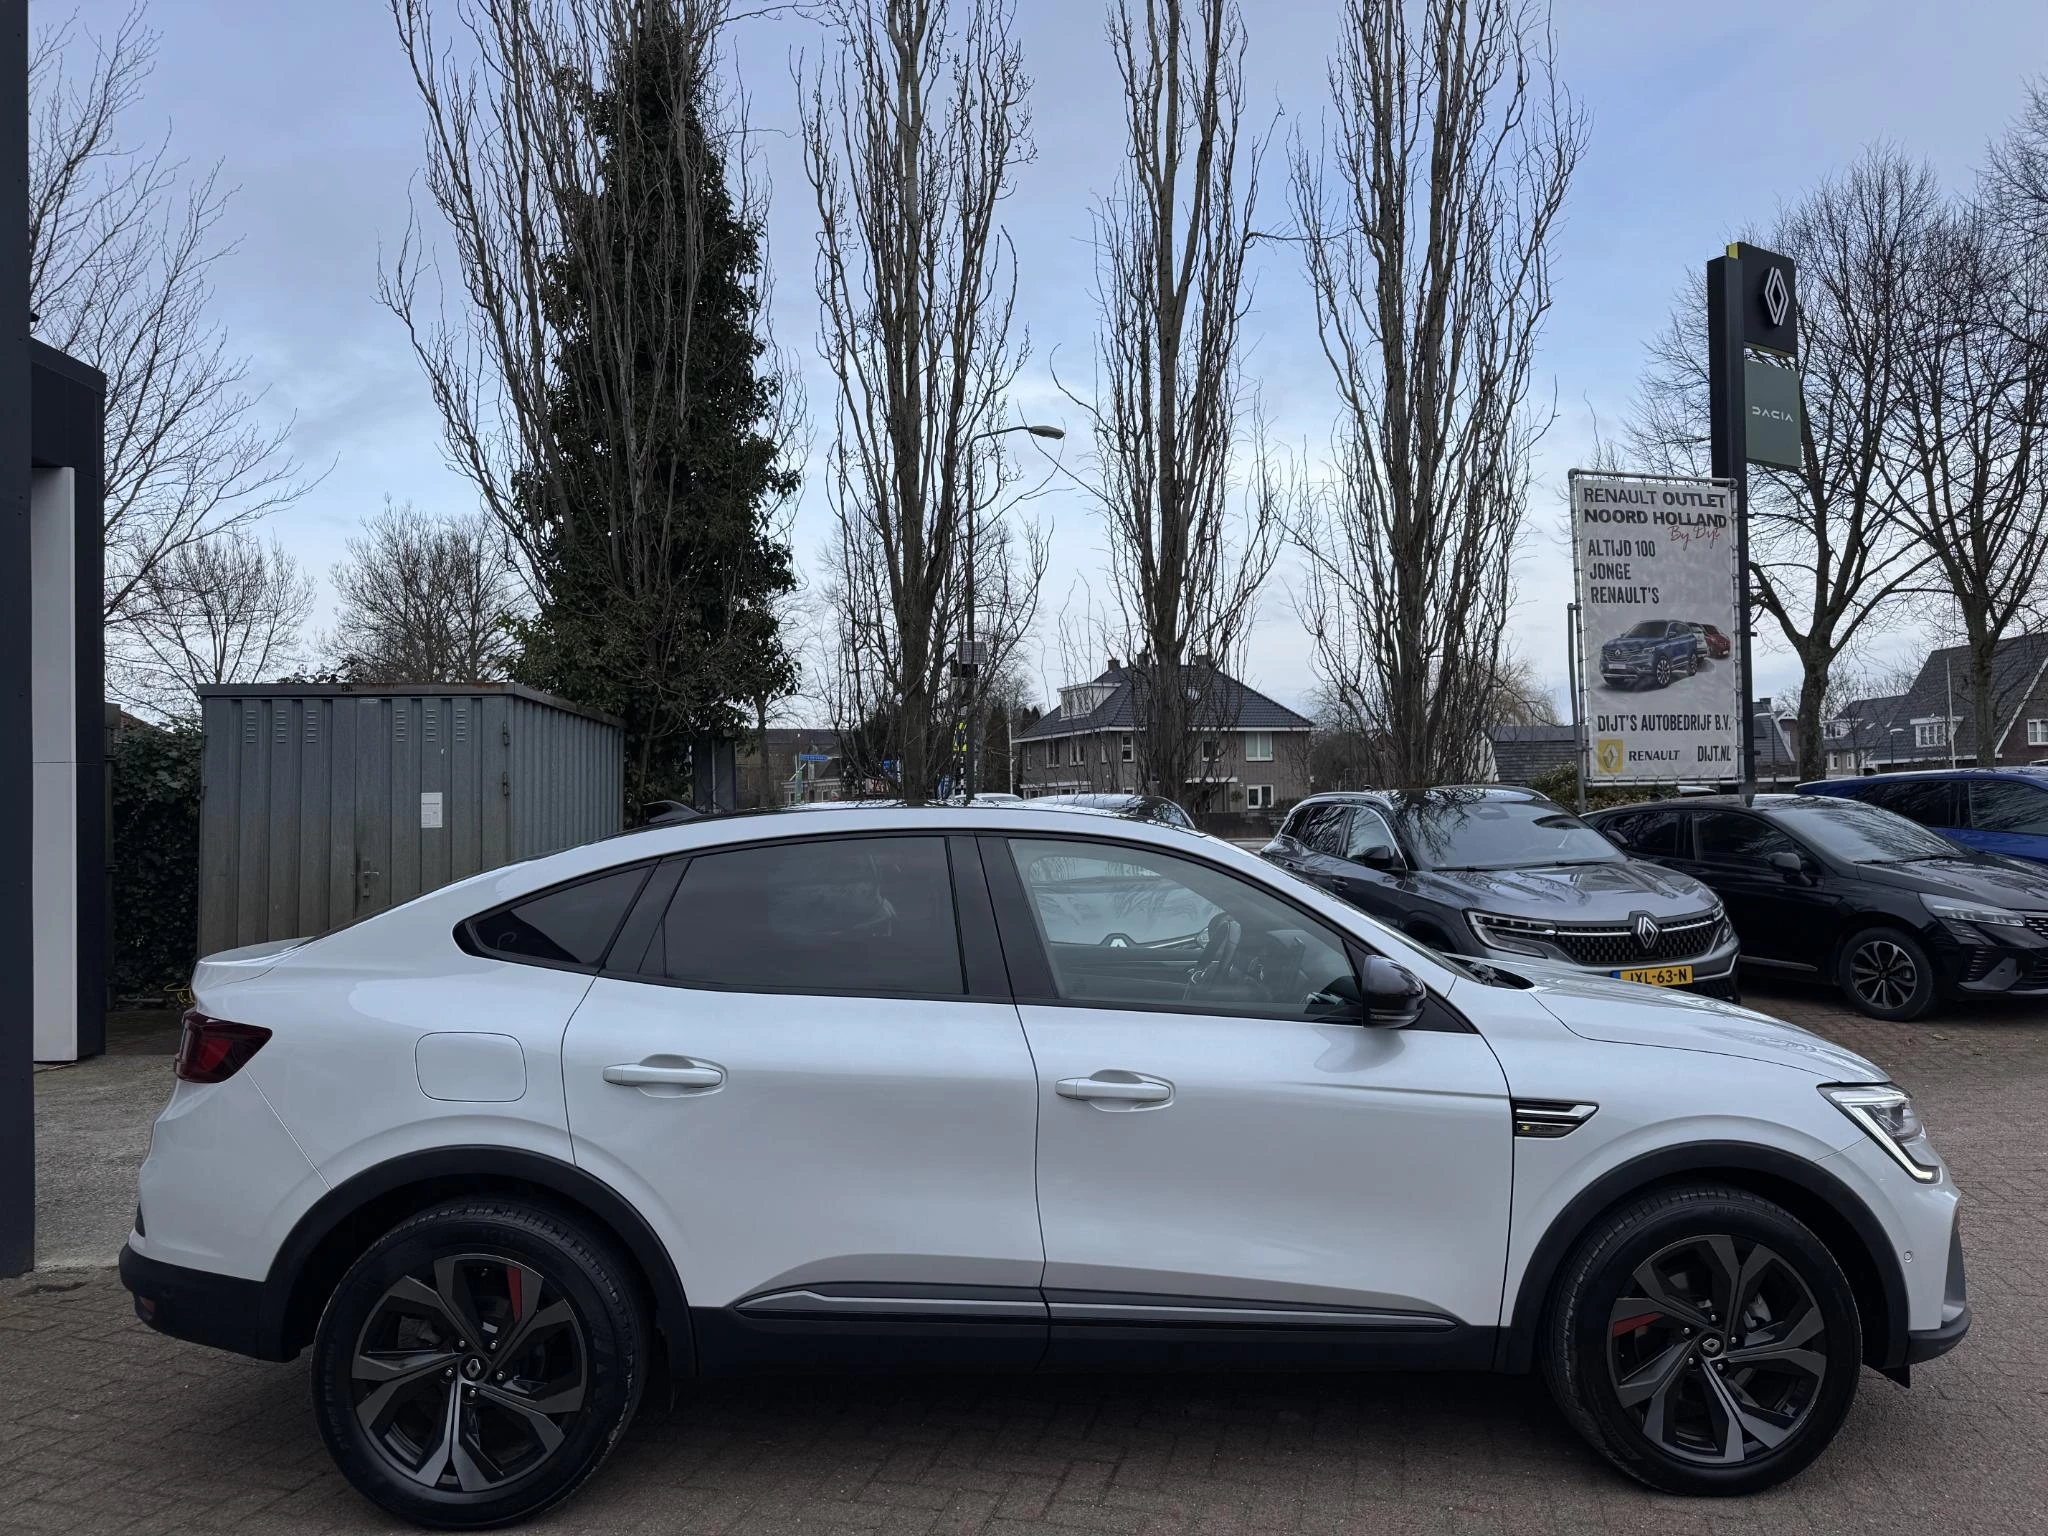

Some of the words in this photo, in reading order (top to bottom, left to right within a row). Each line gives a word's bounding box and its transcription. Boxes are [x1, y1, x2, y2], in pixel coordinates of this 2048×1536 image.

[1751, 405, 1794, 423] DACIA
[1583, 487, 1657, 505] RENAULT
[1662, 491, 1726, 508] OUTLET
[1584, 509, 1649, 524] NOORD
[1652, 511, 1727, 528] HOLLAND
[1668, 525, 1692, 551] By
[1588, 539, 1632, 557] ALTIJD
[1635, 540, 1656, 557] 100
[1589, 563, 1632, 580] JONGE
[1590, 586, 1660, 604] RENAULT'S
[1597, 714, 1638, 732] DIJT'S
[1641, 714, 1712, 731] AUTOBEDRIJF
[1715, 714, 1731, 731] B.V.
[1628, 750, 1680, 761] RENAULT
[1697, 745, 1732, 762] DIJT.NL
